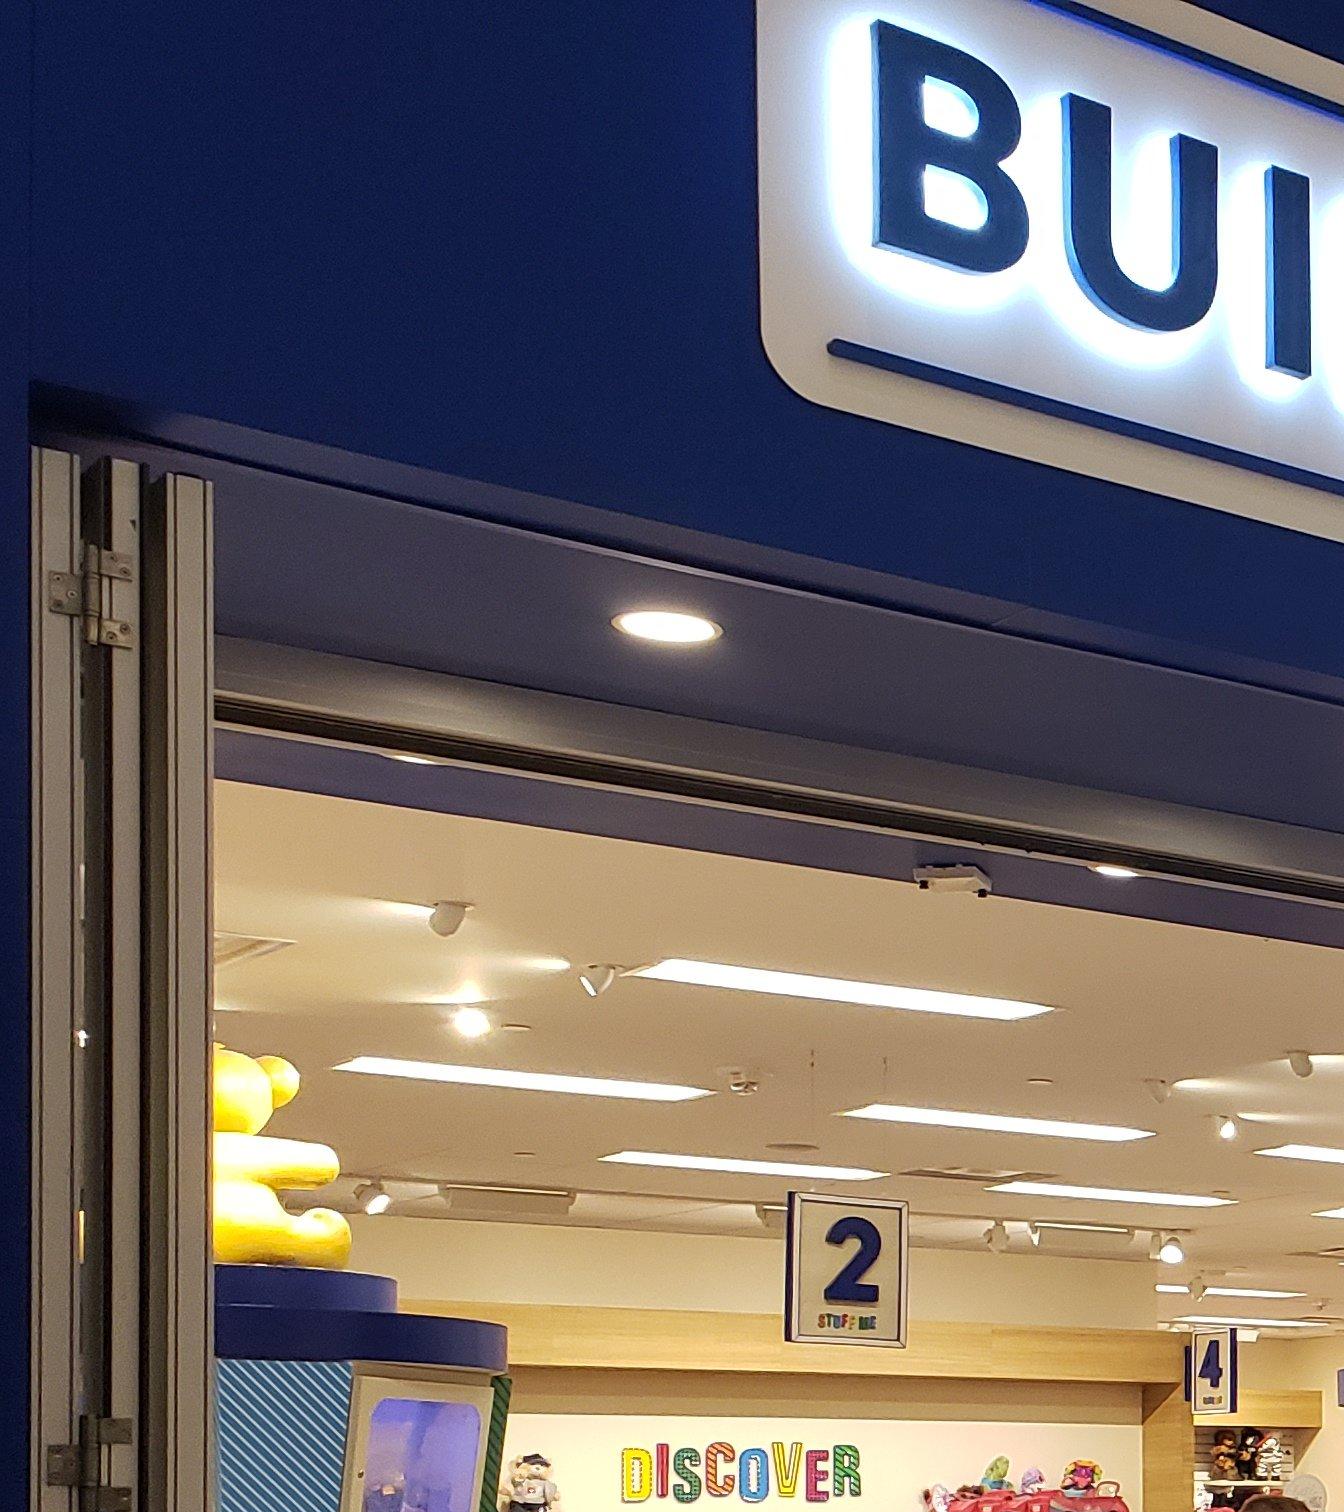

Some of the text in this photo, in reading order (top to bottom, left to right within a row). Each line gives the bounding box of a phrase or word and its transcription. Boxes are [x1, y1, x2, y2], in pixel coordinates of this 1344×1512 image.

[823, 1216, 881, 1303] 2
[818, 1313, 856, 1330] STUFF
[1198, 1340, 1223, 1387] 4
[621, 1441, 862, 1504] DISCOVER
